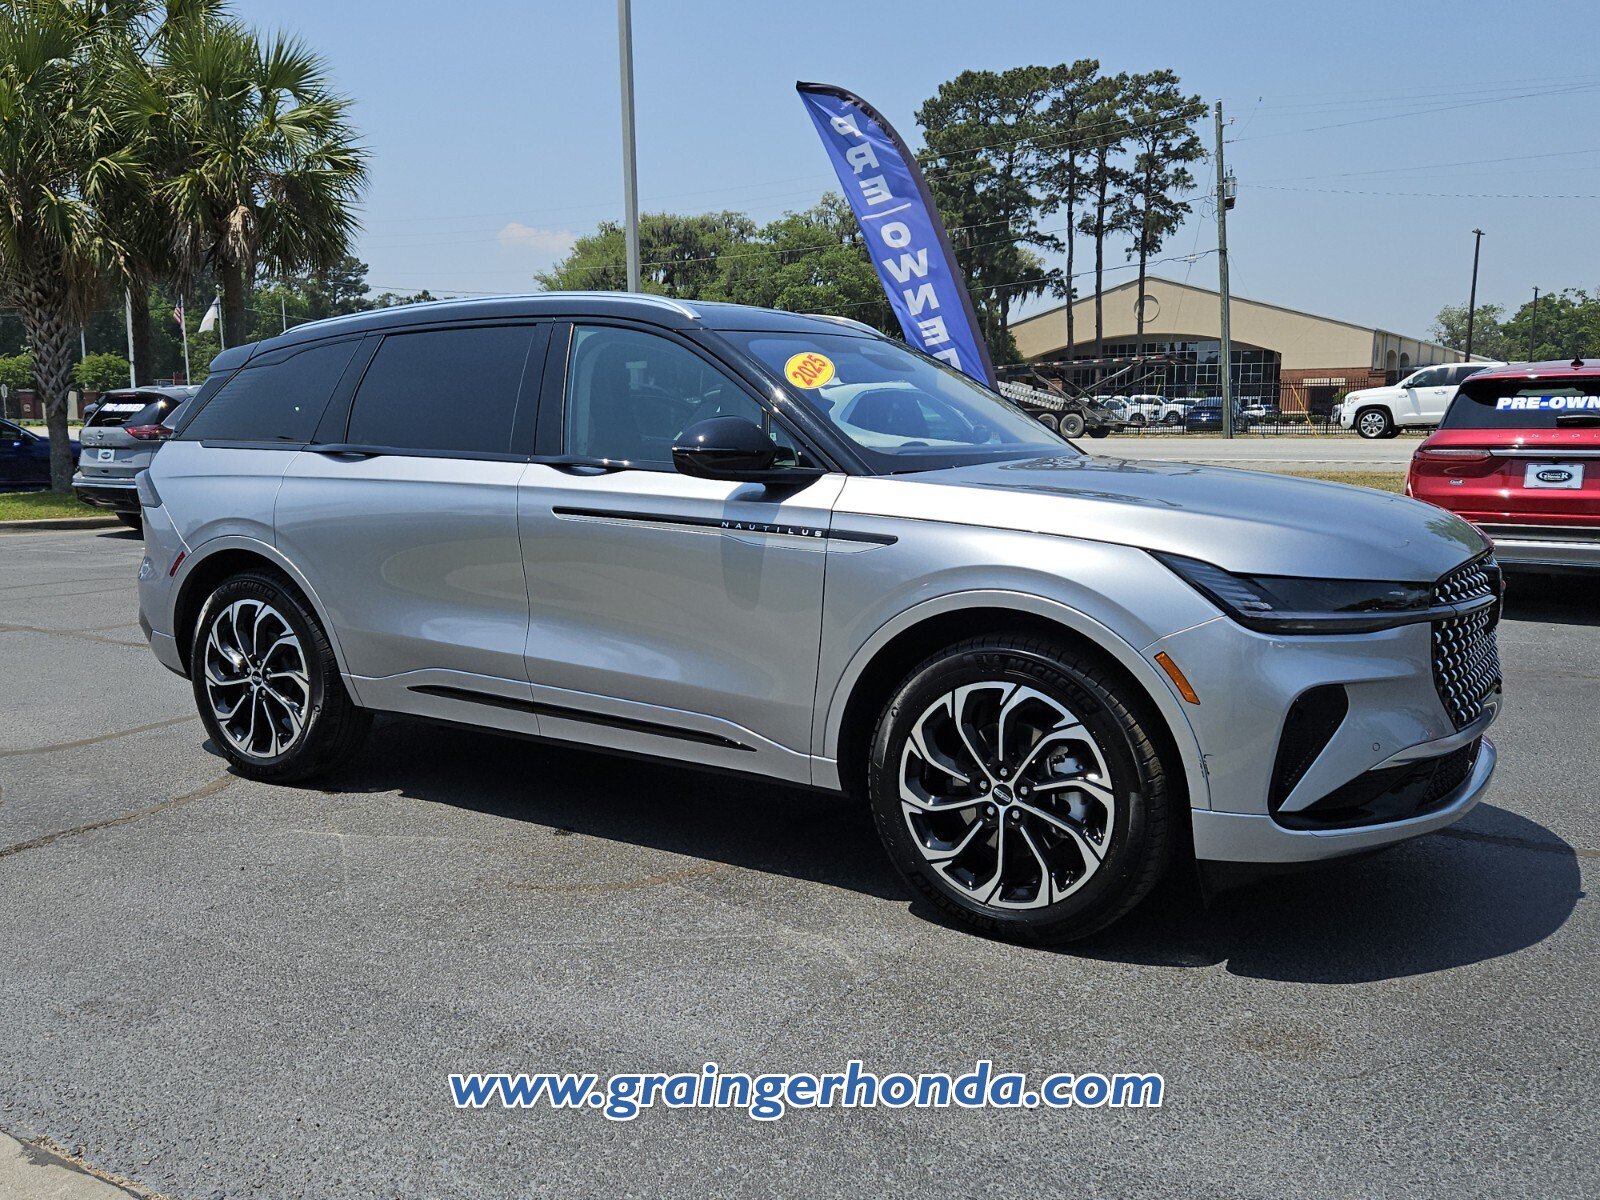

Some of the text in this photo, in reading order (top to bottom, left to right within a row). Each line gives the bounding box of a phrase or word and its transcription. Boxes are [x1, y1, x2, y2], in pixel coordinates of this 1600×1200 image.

[792, 354, 826, 386] 2025
[1496, 396, 1600, 410] PRE-OWN
[721, 521, 823, 537] NAUTILUS
